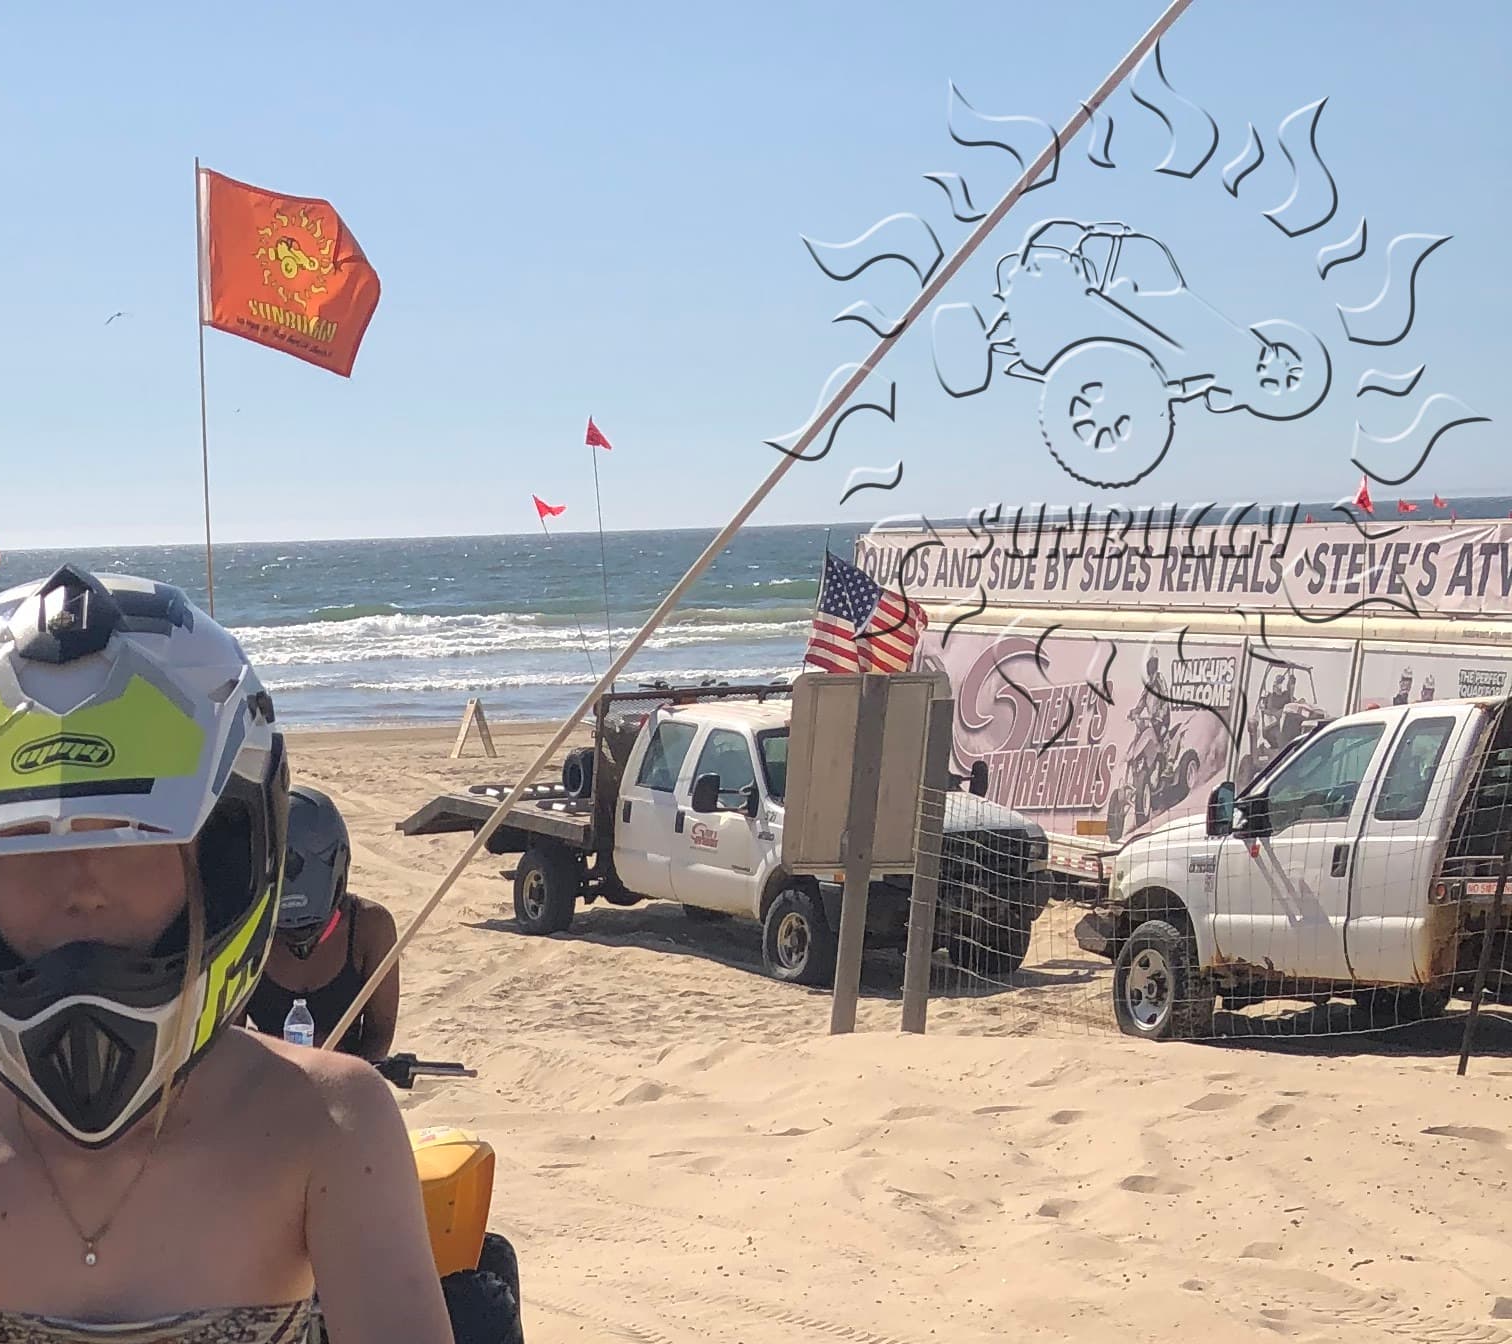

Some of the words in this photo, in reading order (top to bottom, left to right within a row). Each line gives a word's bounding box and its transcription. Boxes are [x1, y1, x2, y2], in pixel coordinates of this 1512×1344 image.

[248, 299, 338, 343] SUNBUGGY
[862, 547, 930, 587] QUADS
[933, 547, 983, 589] AND
[986, 546, 1038, 591] SIDE
[1043, 546, 1078, 592] BY
[1078, 545, 1154, 593] SIDES
[1158, 543, 1284, 595] RENTALS
[1306, 542, 1441, 597] STEVE'S
[1171, 657, 1237, 684] WALK-UPS
[1170, 683, 1232, 710] WELCOME
[1011, 744, 1117, 811] RENTALS
